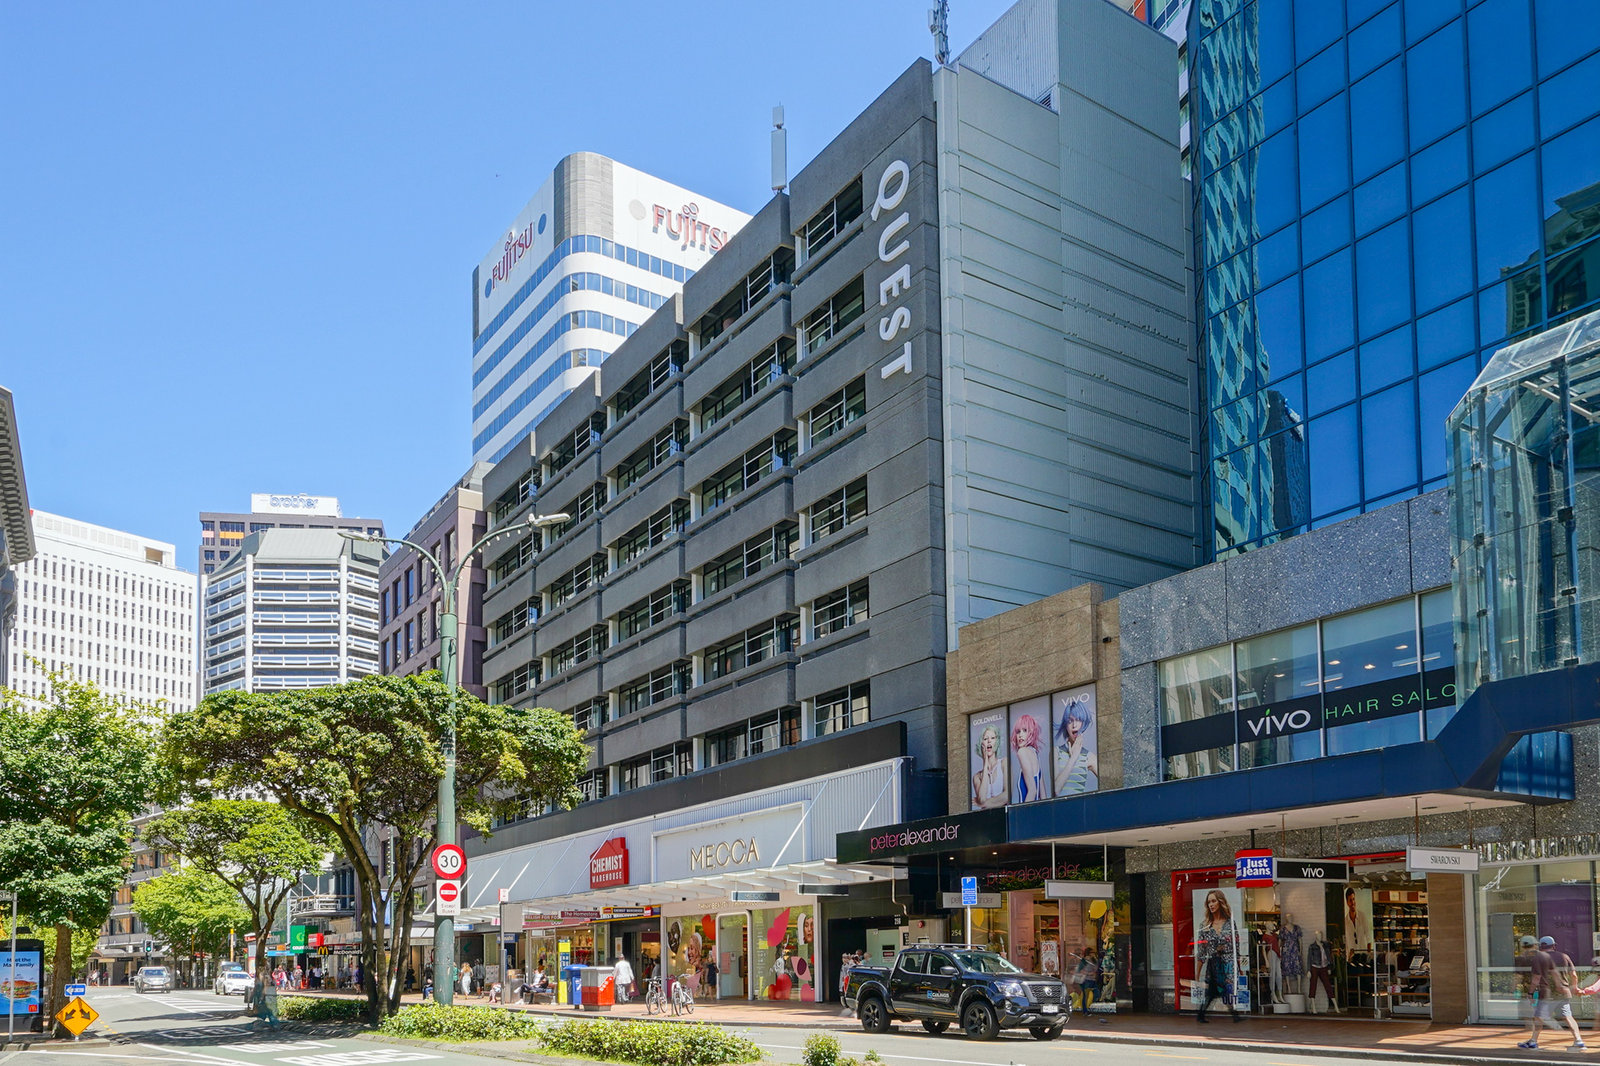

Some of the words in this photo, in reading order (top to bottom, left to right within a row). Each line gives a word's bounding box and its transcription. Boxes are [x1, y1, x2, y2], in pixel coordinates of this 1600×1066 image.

[492, 222, 533, 290] FUJITSU
[870, 159, 912, 380] QUEST
[1061, 692, 1090, 707] VIVO
[1325, 698, 1380, 720] HAIR
[972, 714, 1004, 727] GOLDWELL
[870, 822, 961, 853] peteralexander
[690, 836, 760, 871] MECCA
[1430, 855, 1461, 865] SWAROVSKI
[440, 855, 459, 868] 30
[591, 854, 623, 874] CHEMIST
[1246, 858, 1269, 869] Just
[591, 872, 623, 884] WAREHOUSE
[1242, 866, 1271, 878] Jeans
